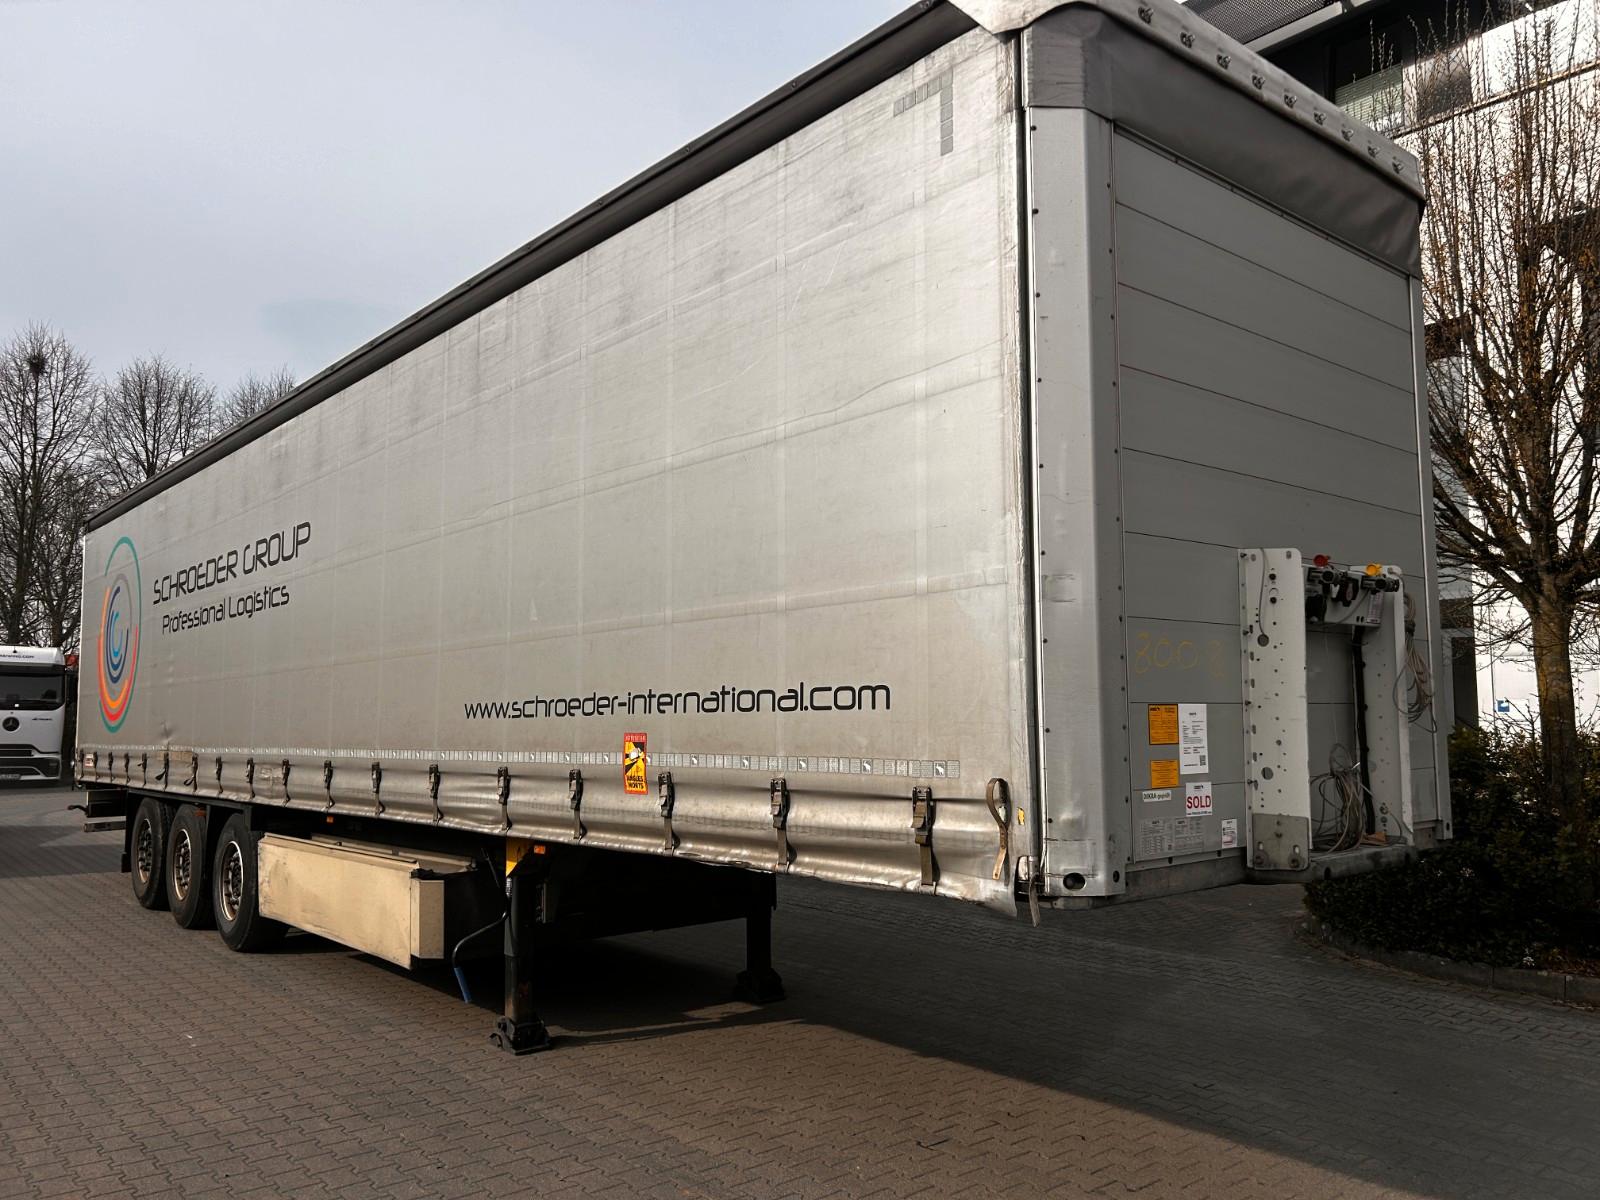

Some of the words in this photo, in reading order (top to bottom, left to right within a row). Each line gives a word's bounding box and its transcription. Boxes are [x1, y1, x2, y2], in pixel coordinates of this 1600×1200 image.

[153, 549, 239, 605] SCHROEDER
[242, 521, 311, 575] GROUP
[162, 597, 226, 635] Professional
[228, 585, 290, 619] Logistics
[464, 681, 891, 720] www.schroeder-international.com
[1186, 795, 1212, 809] SOLD
